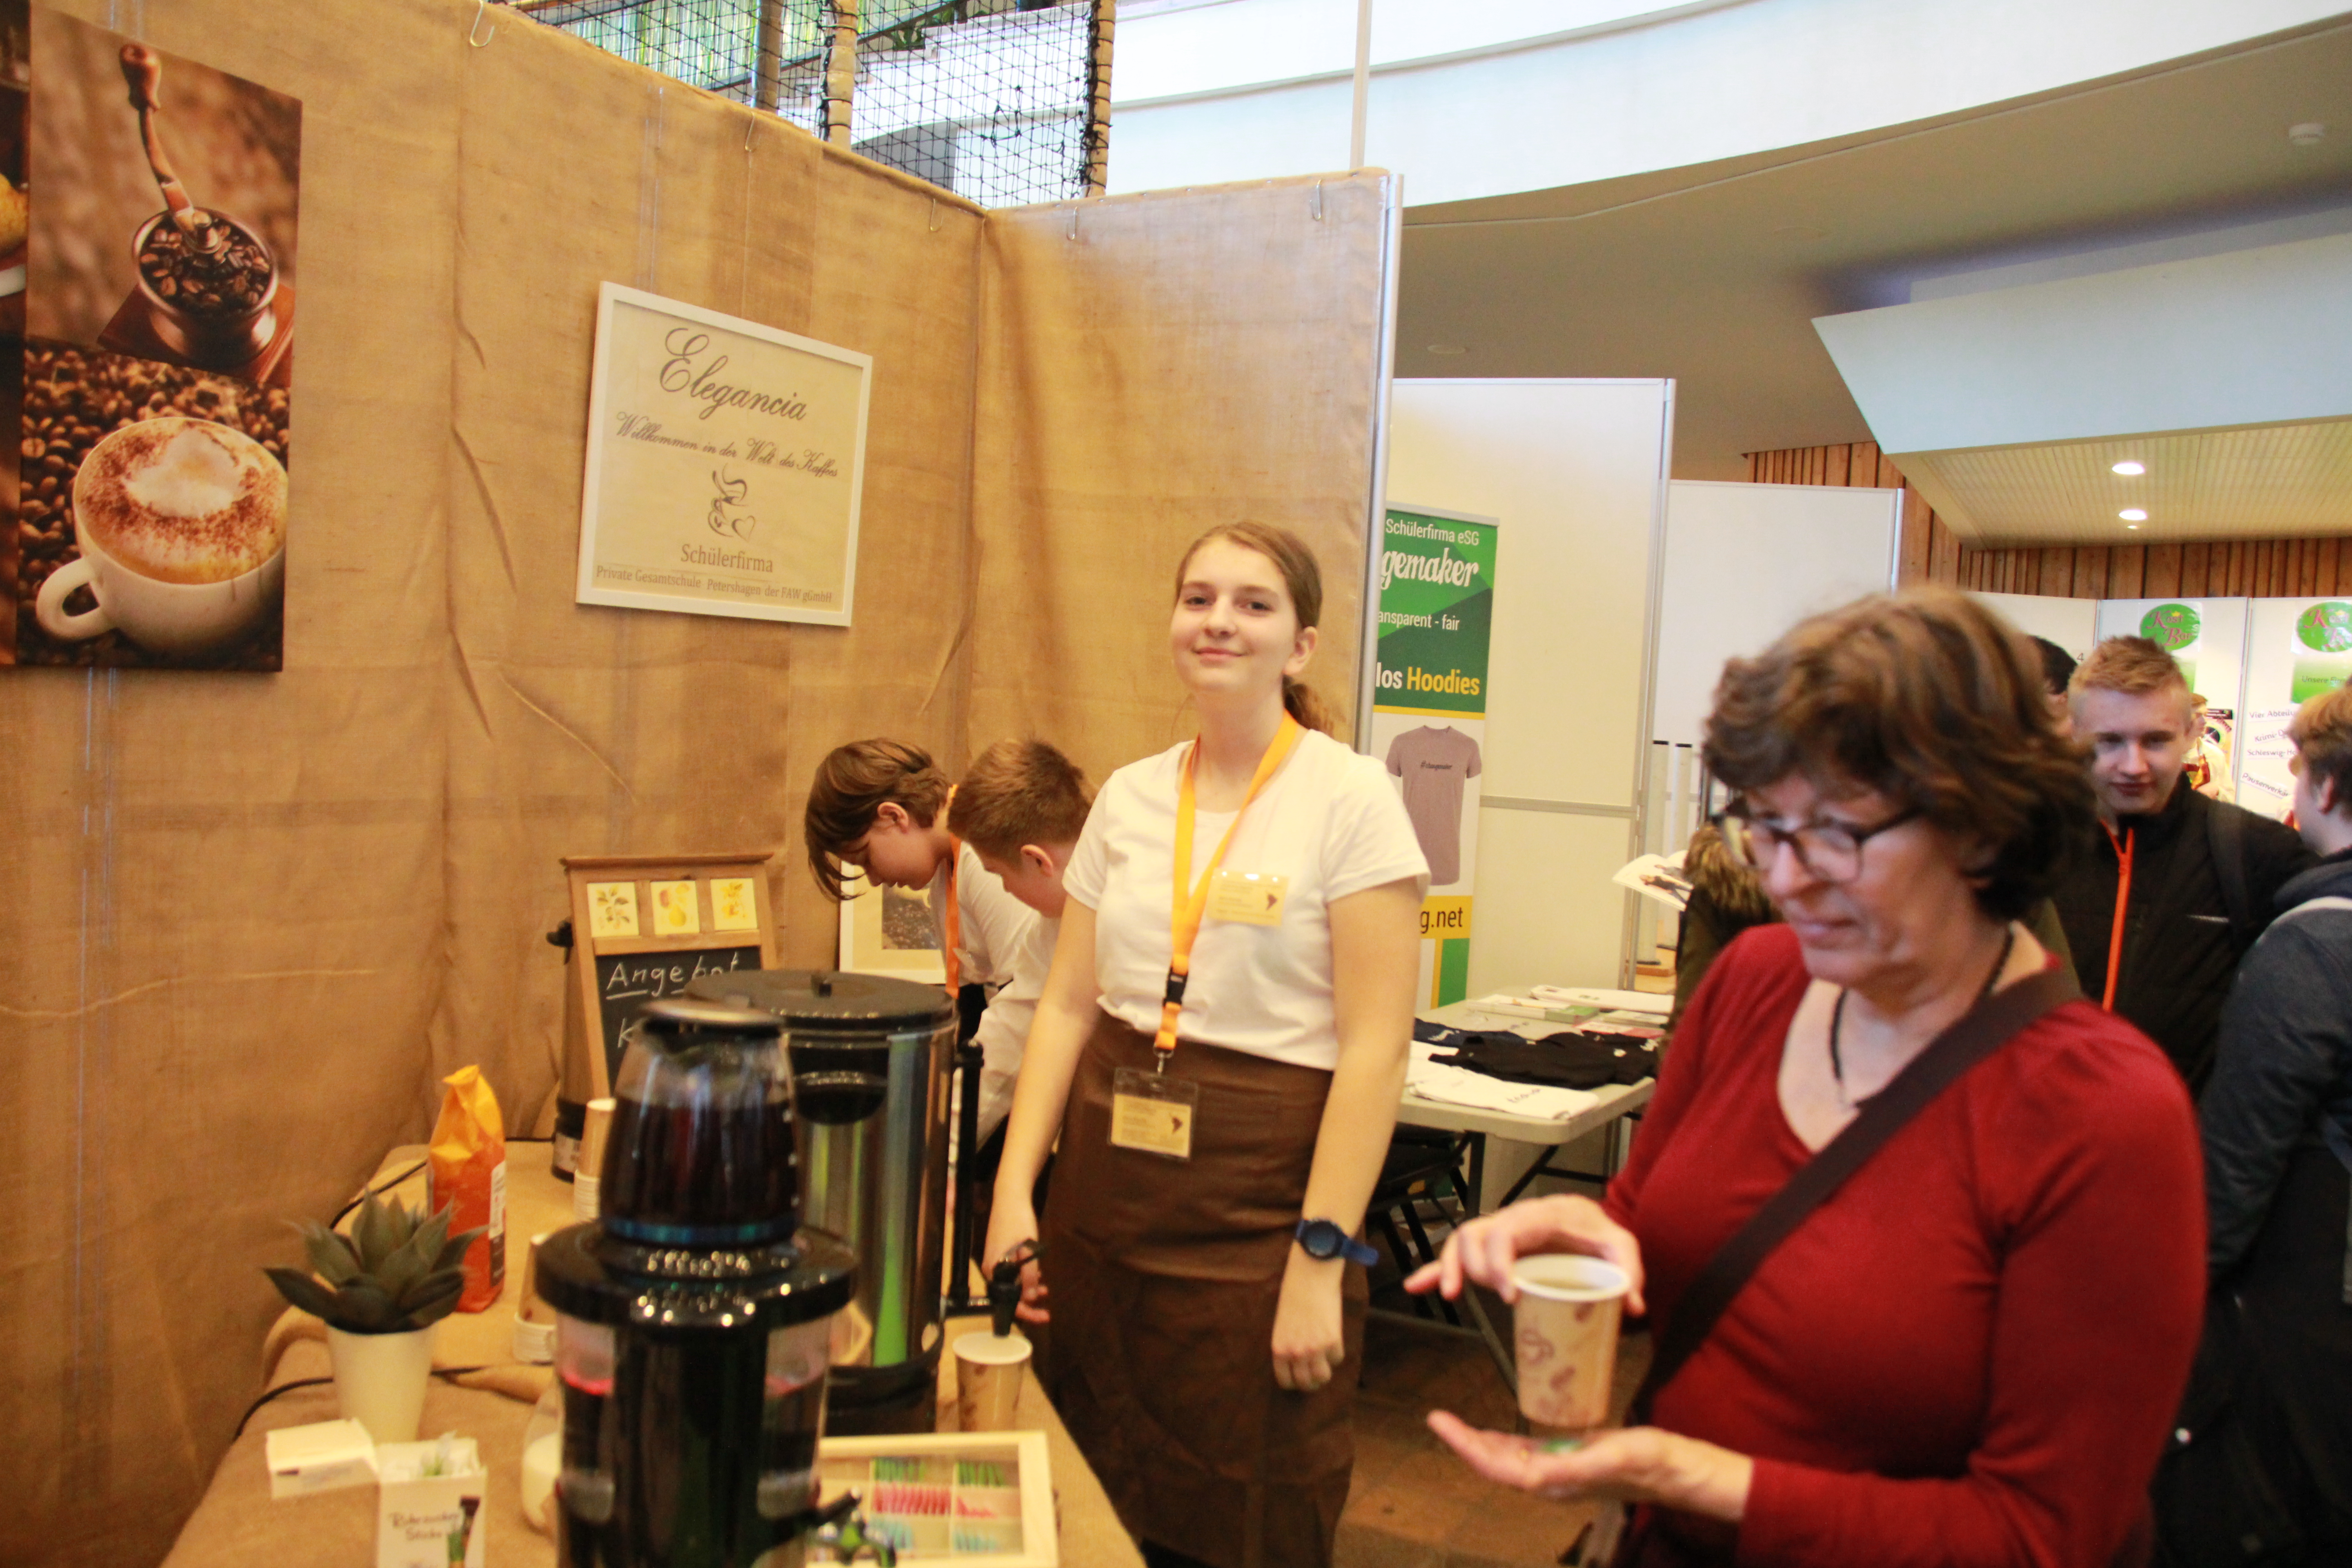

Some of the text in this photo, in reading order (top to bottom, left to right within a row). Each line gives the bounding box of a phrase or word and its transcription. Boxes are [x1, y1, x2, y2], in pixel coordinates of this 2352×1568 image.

[660, 328, 807, 420] Elegancia
[616, 412, 838, 477] Willkommen in der Welt des Kaffees
[1386, 518, 1480, 546] Schülerfirma eSG
[681, 544, 773, 573] Schülerfirma
[596, 565, 832, 603] Private Gesamtschule Petershagen der FAW gGmbH
[1442, 614, 1460, 631] fair
[1407, 666, 1480, 696] Hoodies
[1420, 906, 1463, 934] g.net
